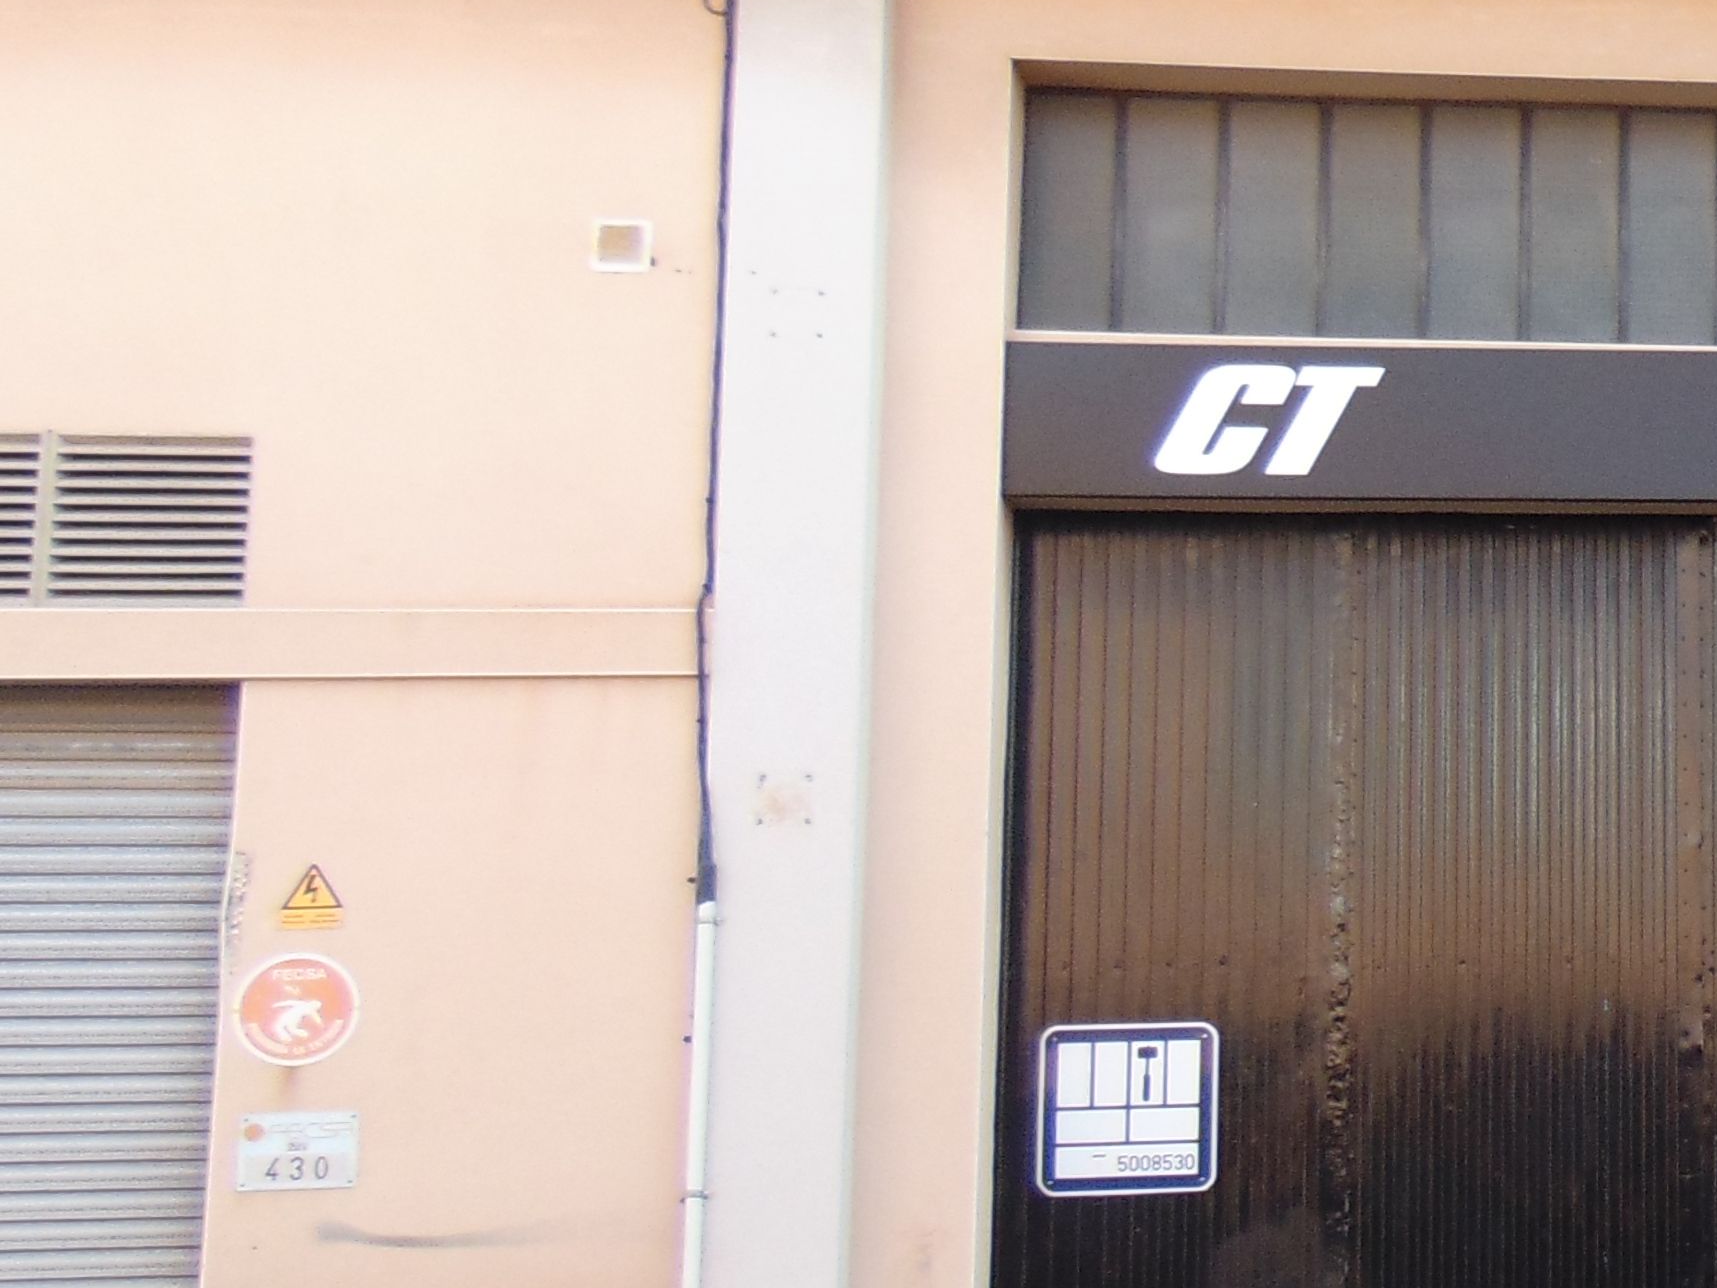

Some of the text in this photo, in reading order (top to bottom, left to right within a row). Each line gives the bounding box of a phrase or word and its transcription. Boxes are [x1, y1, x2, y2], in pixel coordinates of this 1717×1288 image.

[1153, 364, 1386, 475] CT
[264, 1155, 329, 1181] 430
[1117, 1153, 1196, 1173] 5008530
